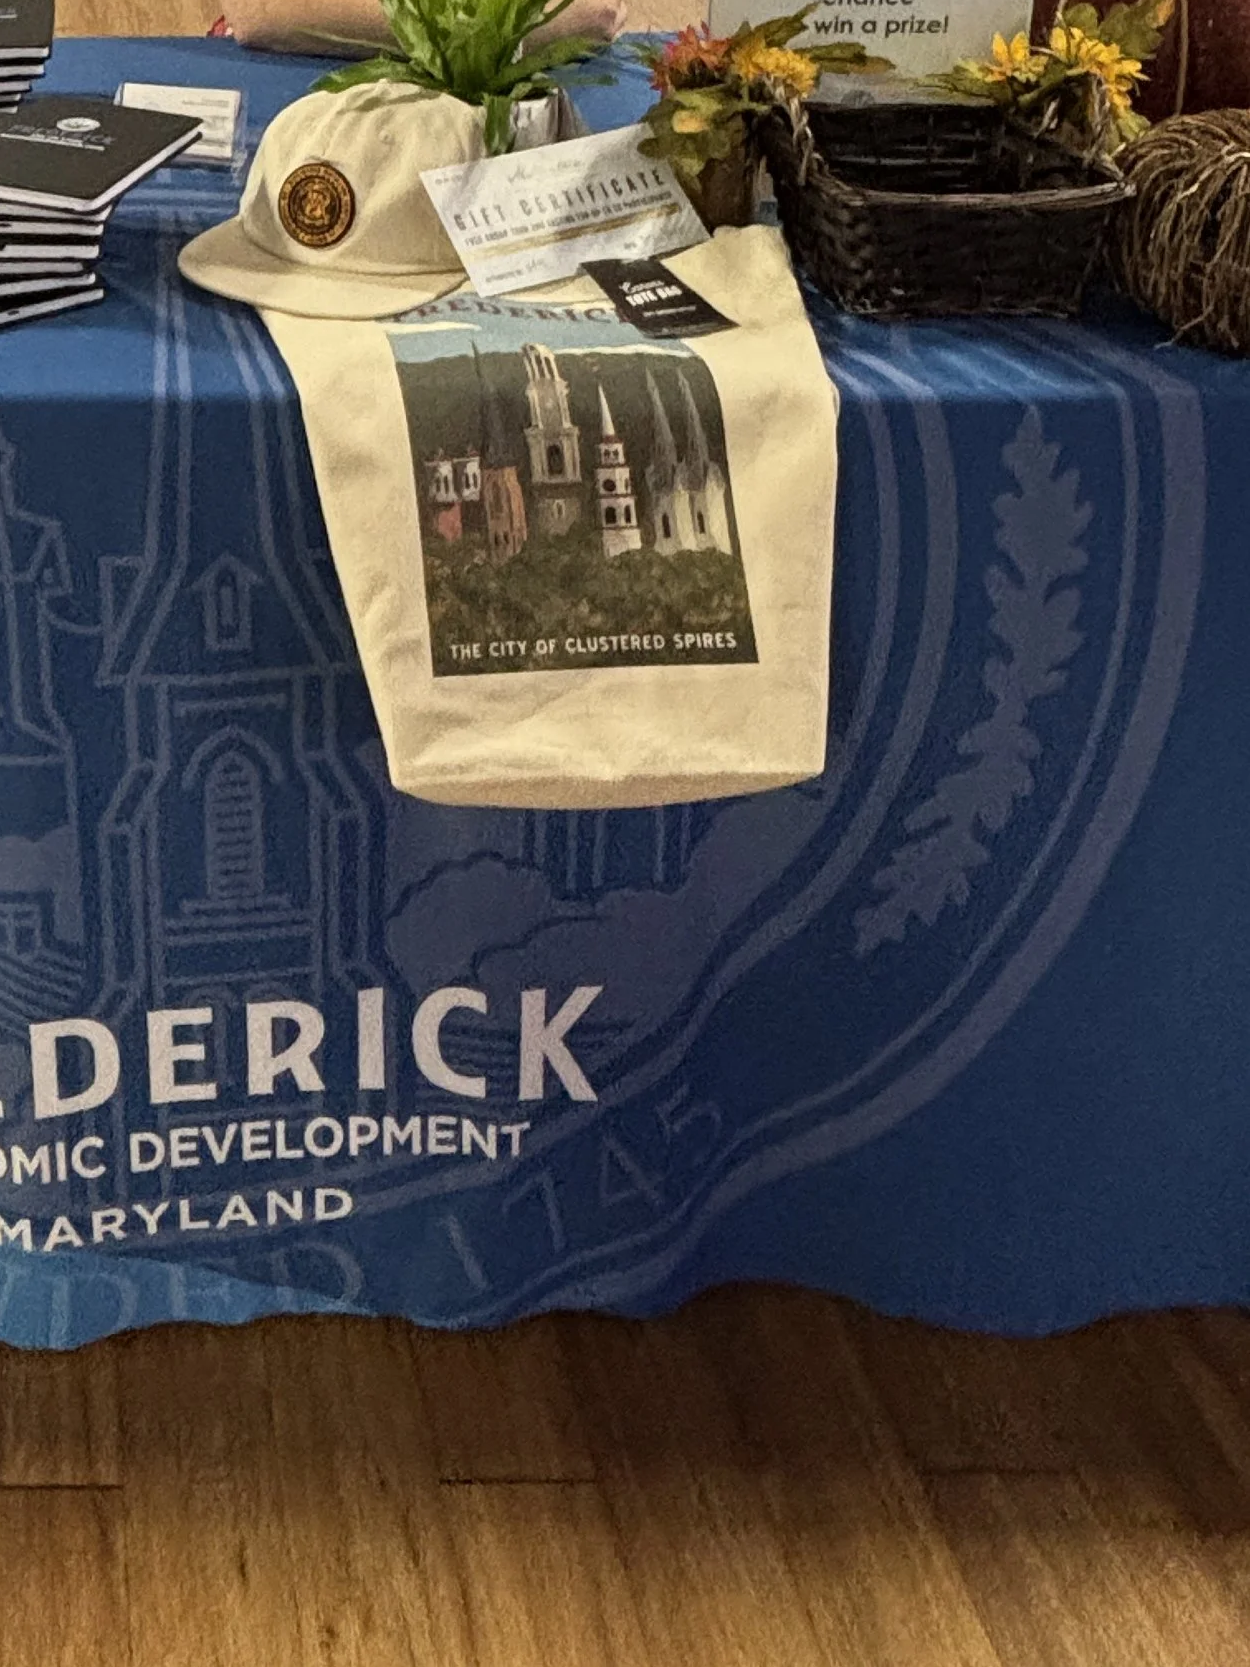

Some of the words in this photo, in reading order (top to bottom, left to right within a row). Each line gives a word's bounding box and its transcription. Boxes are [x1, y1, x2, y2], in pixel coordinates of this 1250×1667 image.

[813, 16, 854, 34] win
[861, 20, 877, 34] a
[884, 15, 949, 38] prize!
[453, 205, 507, 231] GIFT
[519, 168, 665, 217] CERTIFICATE
[393, 297, 631, 325] REDERIC
[449, 642, 481, 660] THE
[488, 639, 527, 658] CITY
[535, 638, 556, 655] OF
[564, 634, 666, 654] CLUSTERED
[673, 632, 738, 649] SPIRES
[130, 1115, 530, 1174] DEVELOPMENT
